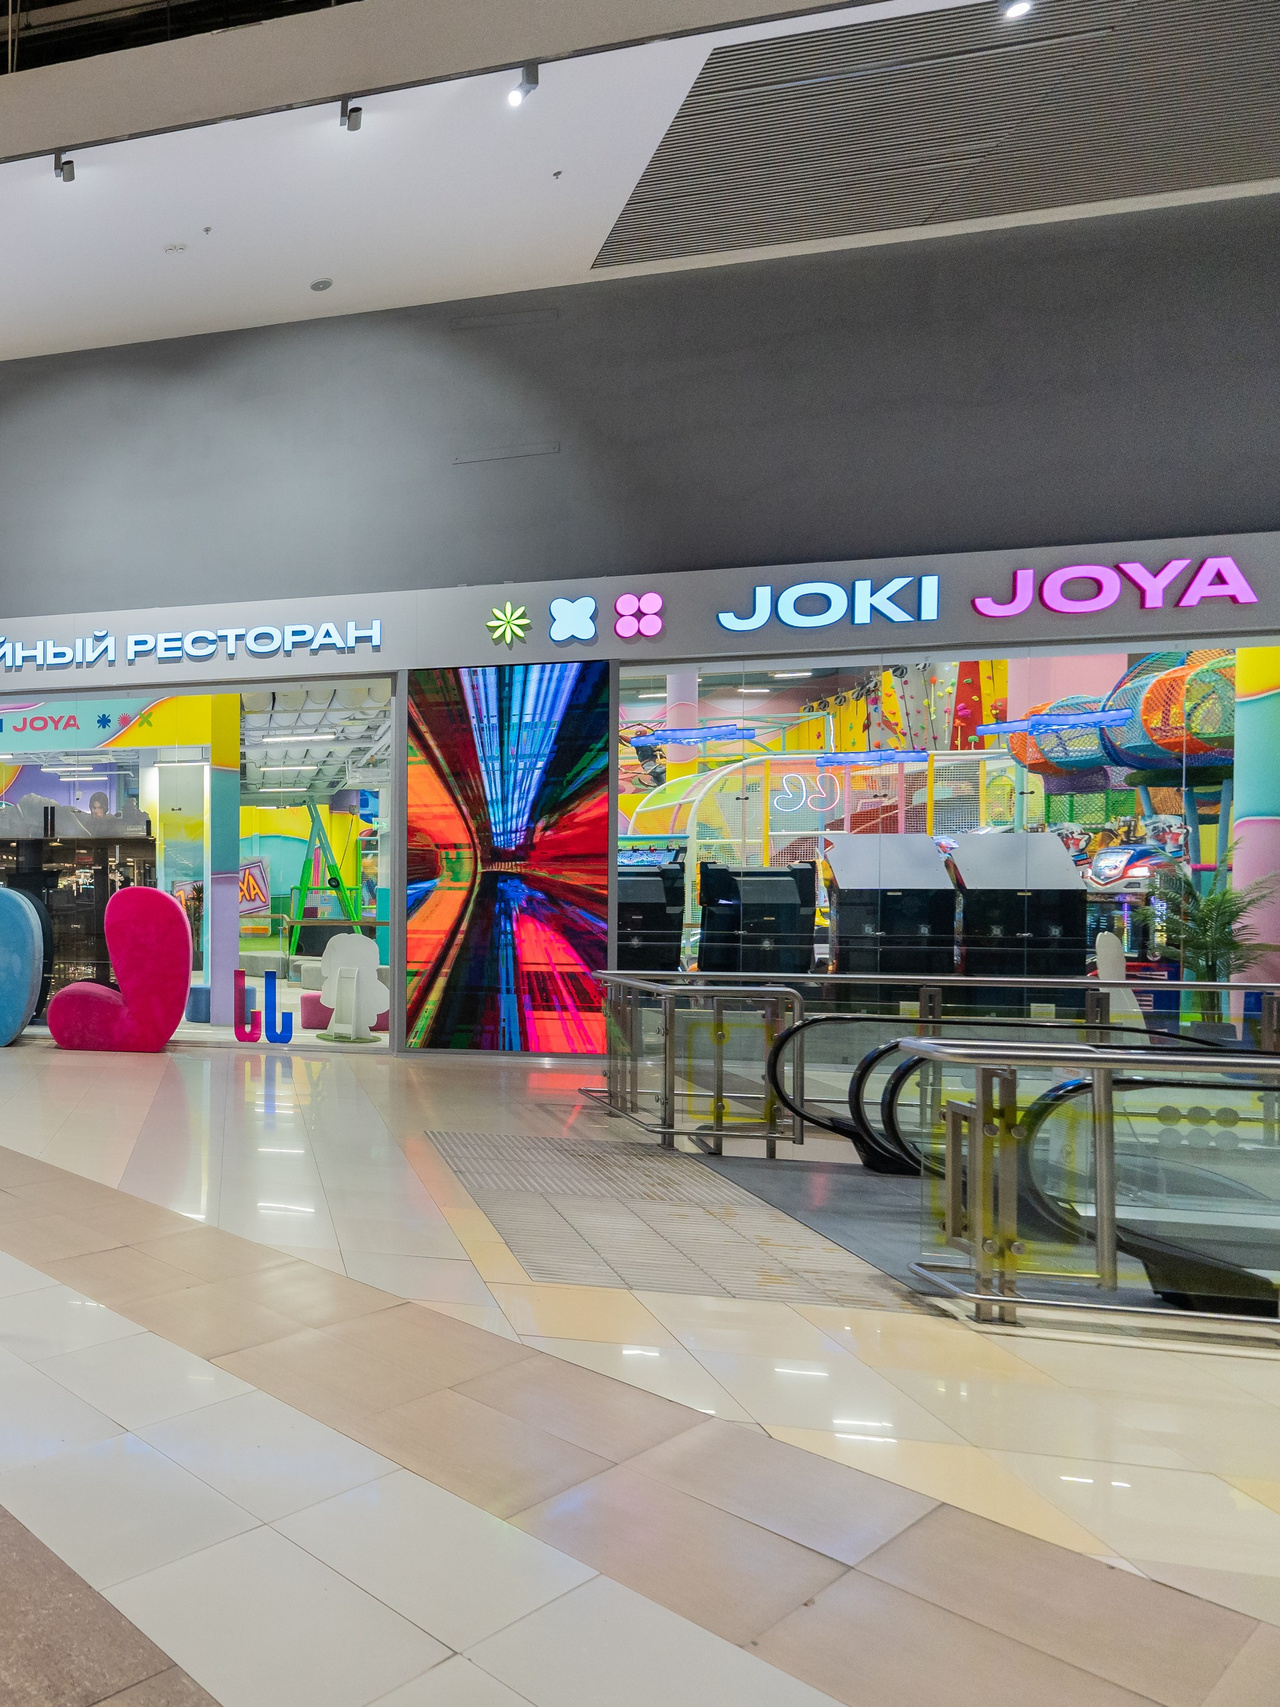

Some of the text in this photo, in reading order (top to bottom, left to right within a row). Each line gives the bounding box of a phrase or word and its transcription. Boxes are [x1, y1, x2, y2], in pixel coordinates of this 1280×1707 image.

[720, 556, 1258, 632] JOKI JOYA
[127, 619, 381, 661] РЕСТОРАН
[12, 715, 80, 733] JOYA
